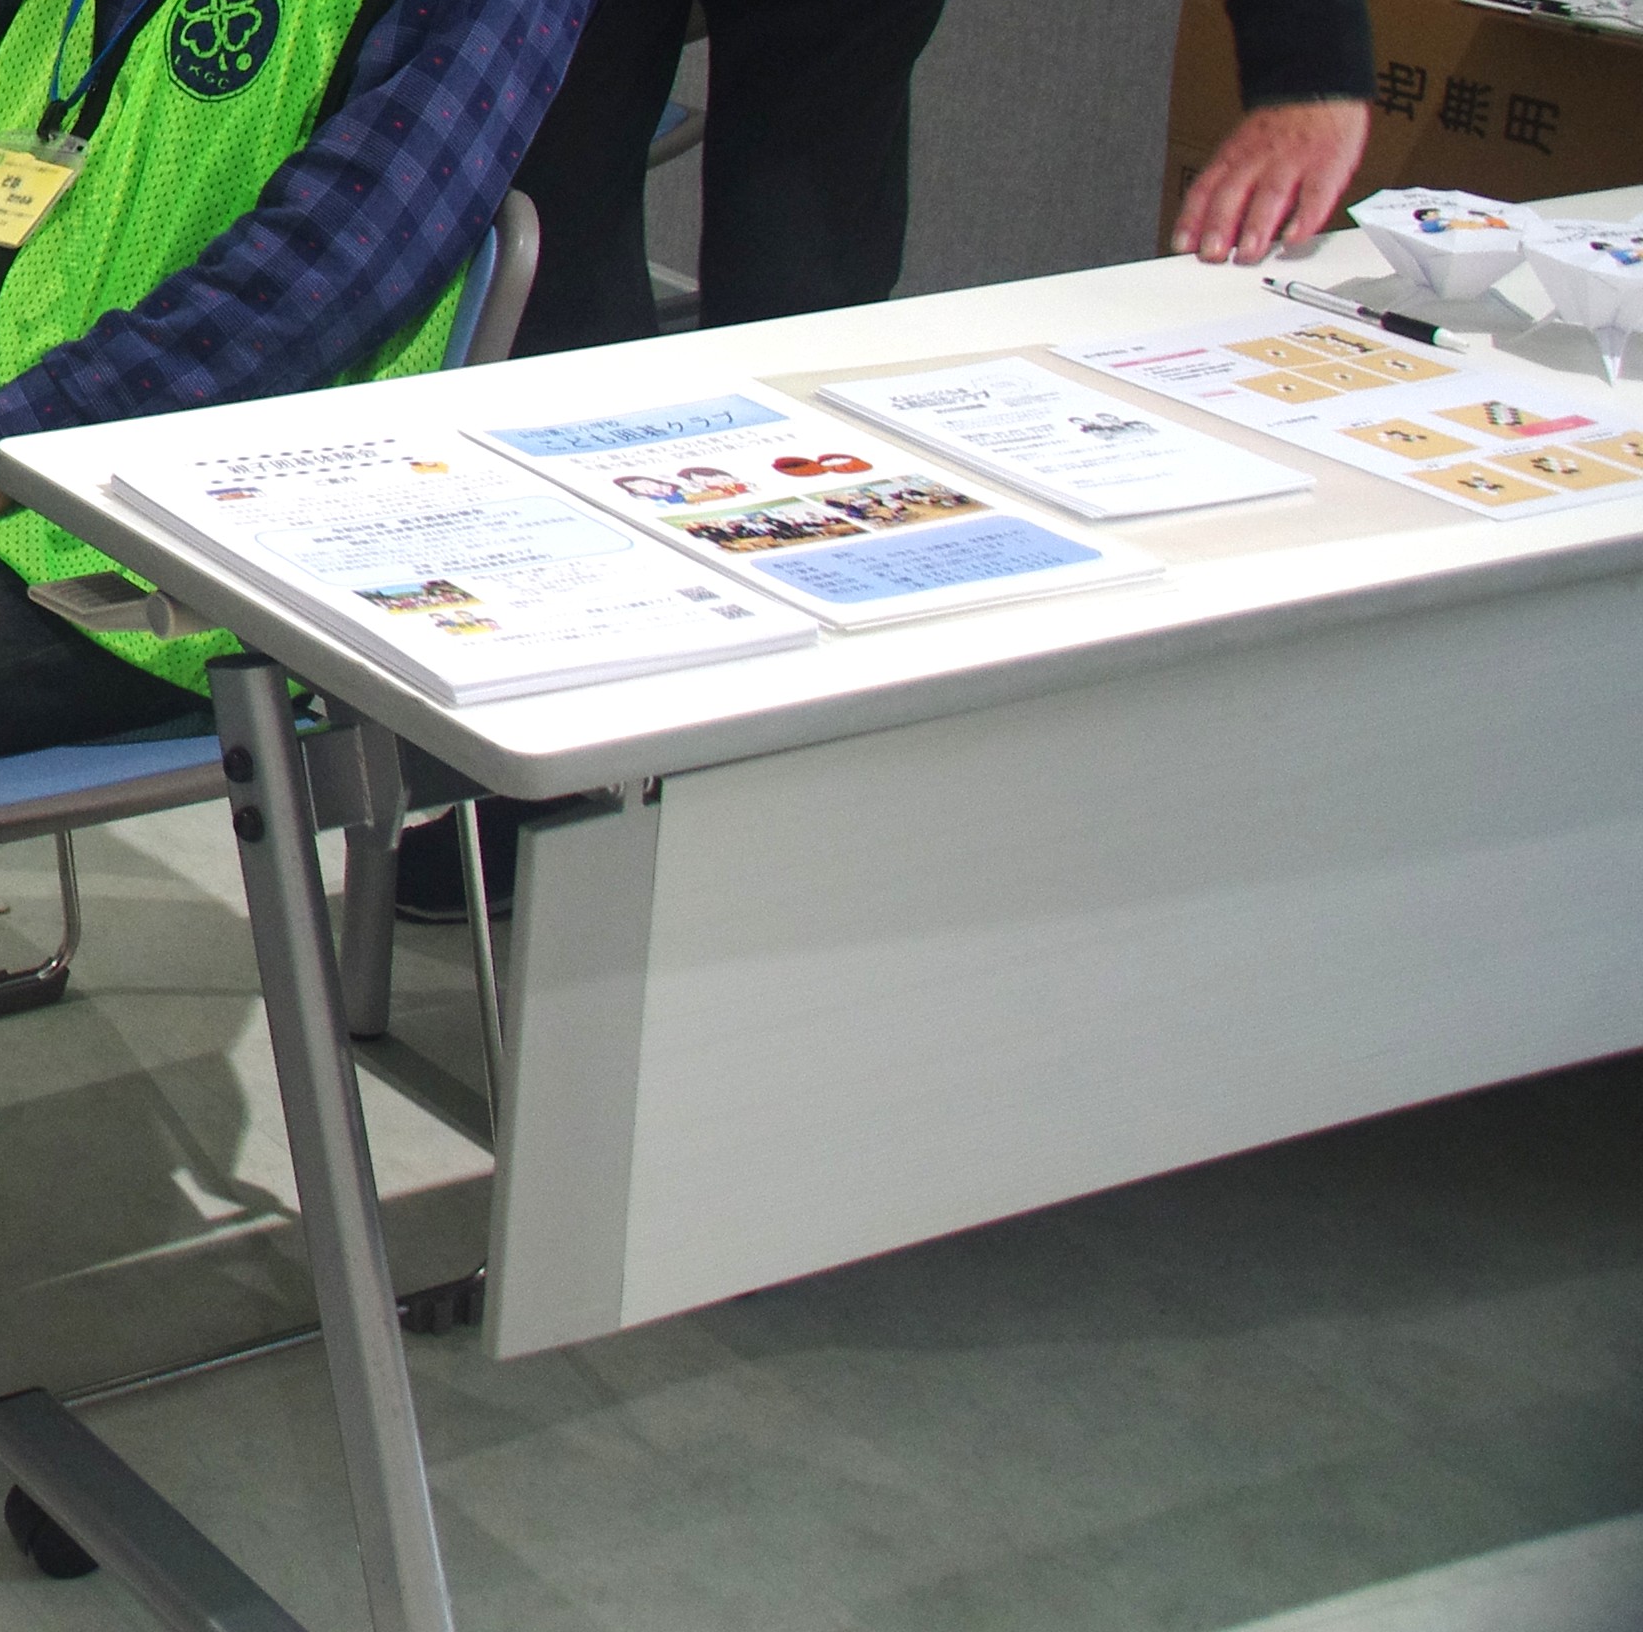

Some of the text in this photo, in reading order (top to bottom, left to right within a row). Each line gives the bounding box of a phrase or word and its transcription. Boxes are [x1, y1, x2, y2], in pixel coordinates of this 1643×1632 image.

[540, 410, 737, 453] こども囲碁クラブ
